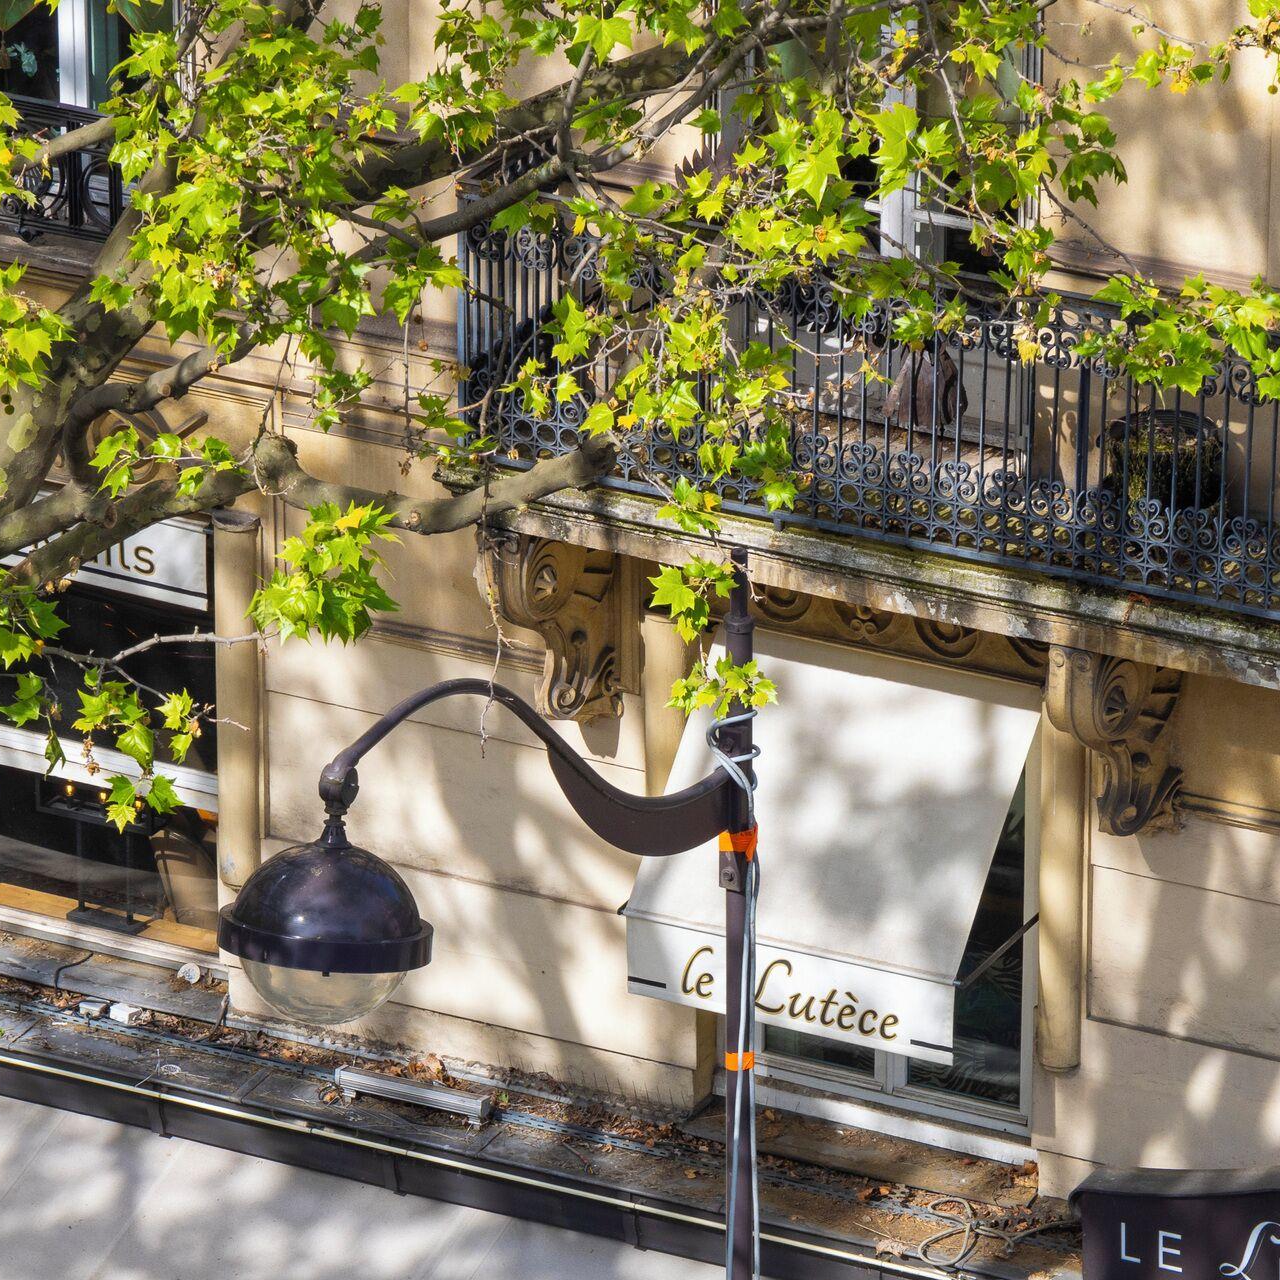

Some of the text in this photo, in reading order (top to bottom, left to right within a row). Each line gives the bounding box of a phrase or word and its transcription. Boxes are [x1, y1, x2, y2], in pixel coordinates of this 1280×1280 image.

[681, 946, 900, 1041] le Lutèce
[1120, 1222, 1183, 1273] LE
